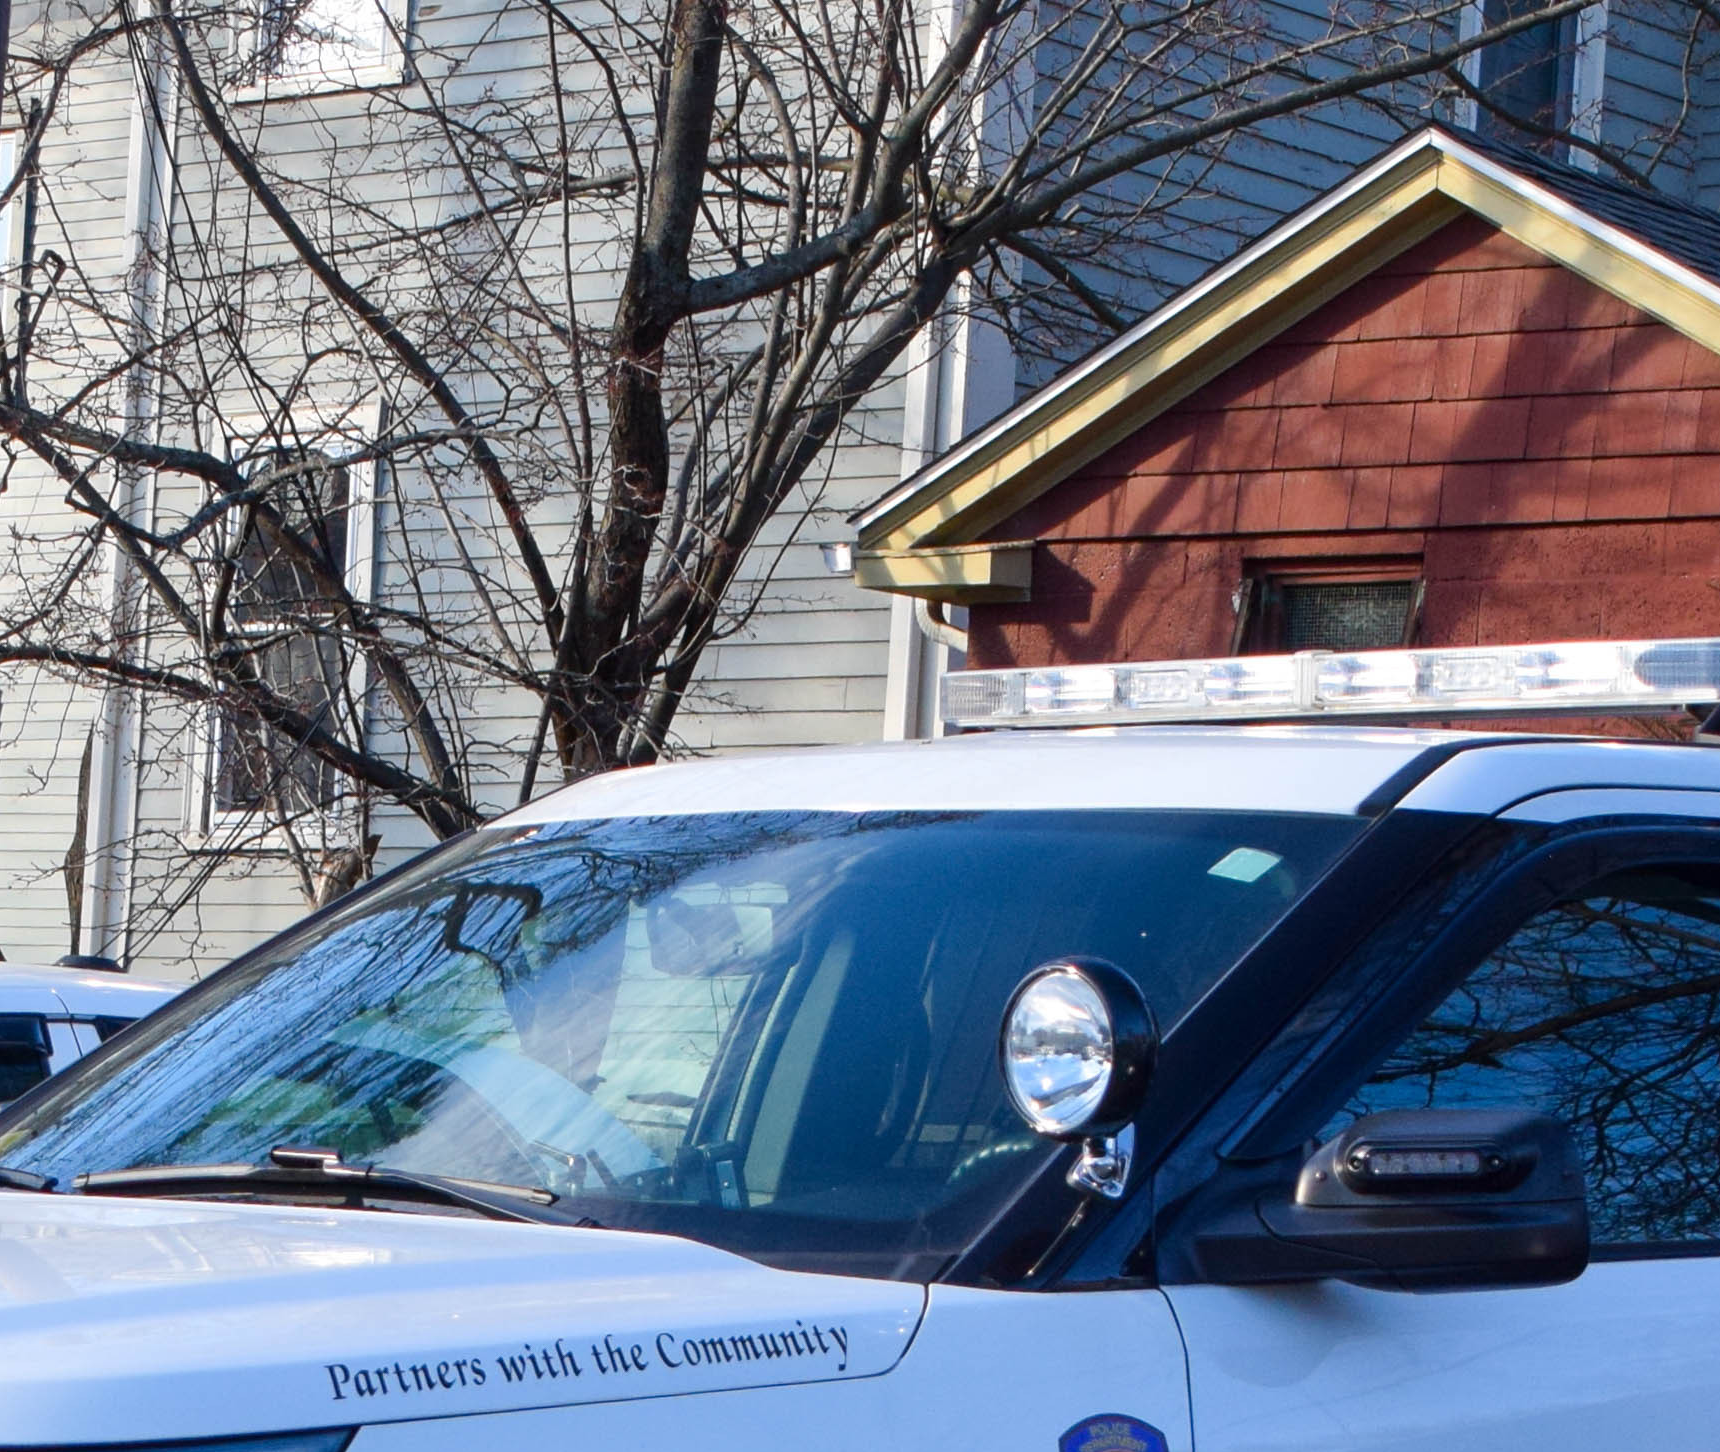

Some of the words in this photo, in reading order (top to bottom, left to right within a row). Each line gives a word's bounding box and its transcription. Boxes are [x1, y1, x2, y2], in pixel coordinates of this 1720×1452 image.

[324, 1354, 487, 1401] Partners
[495, 1338, 583, 1382] with
[590, 1333, 650, 1375] the
[655, 1319, 850, 1372] Community
